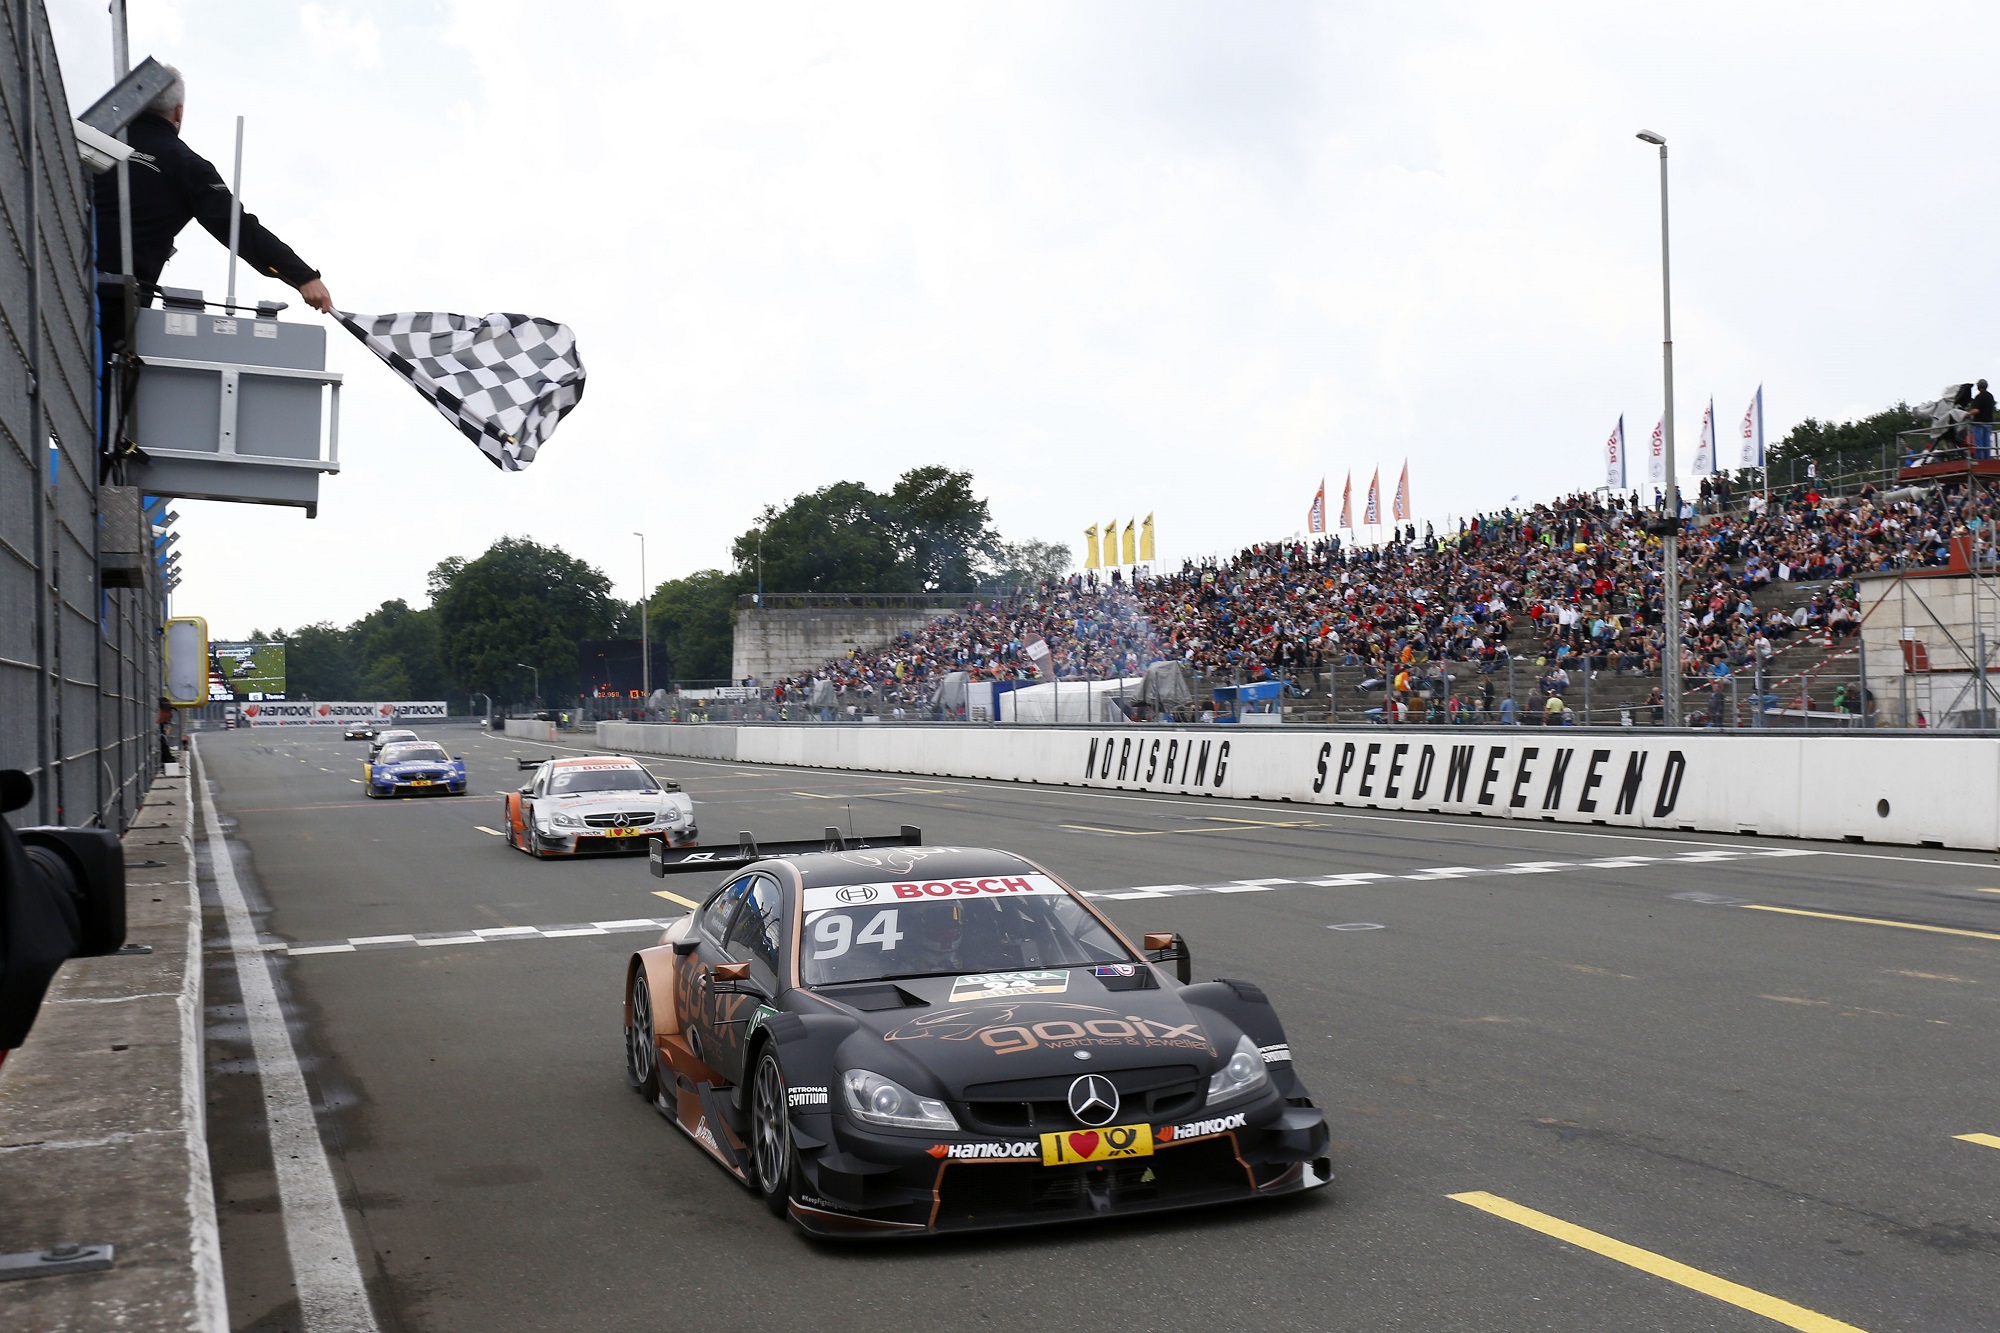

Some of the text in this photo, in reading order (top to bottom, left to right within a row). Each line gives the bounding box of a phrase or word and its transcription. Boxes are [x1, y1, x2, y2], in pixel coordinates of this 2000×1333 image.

[553, 774, 572, 787] 6
[1085, 737, 1687, 818] NORISRING SPEEDWEEKEND
[891, 877, 1035, 899] BOSCH
[813, 908, 904, 960] 94
[963, 971, 1062, 984] DEKRA
[979, 1015, 1208, 1055] gooix
[1044, 1037, 1120, 1050] watches
[1125, 1036, 1141, 1047] &
[788, 1086, 828, 1094] PETRONAS
[788, 1092, 828, 1106] SYNTIUM
[1055, 1134, 1064, 1162] I
